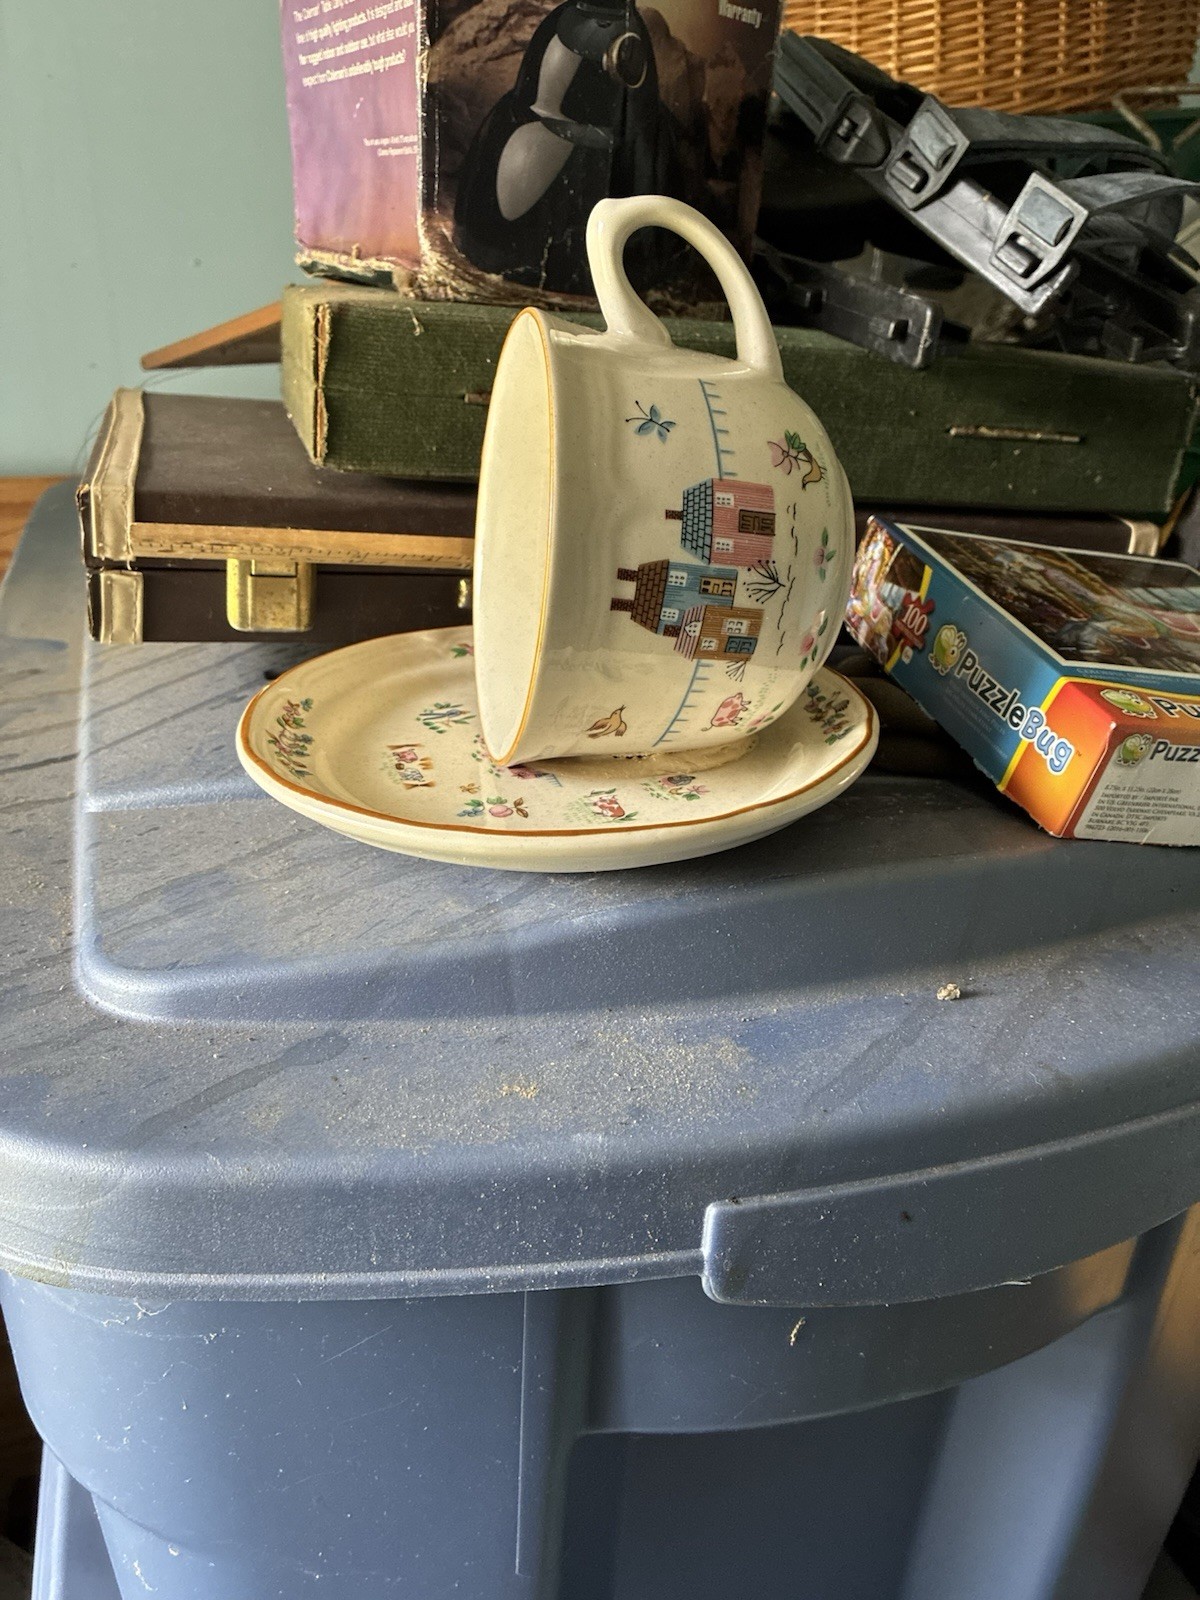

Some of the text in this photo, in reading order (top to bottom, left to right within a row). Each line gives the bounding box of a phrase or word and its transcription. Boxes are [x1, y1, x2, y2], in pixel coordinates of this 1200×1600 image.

[719, 0, 762, 28] Warranty
[902, 604, 928, 636] 100
[956, 648, 1073, 773] PuzzleBug
